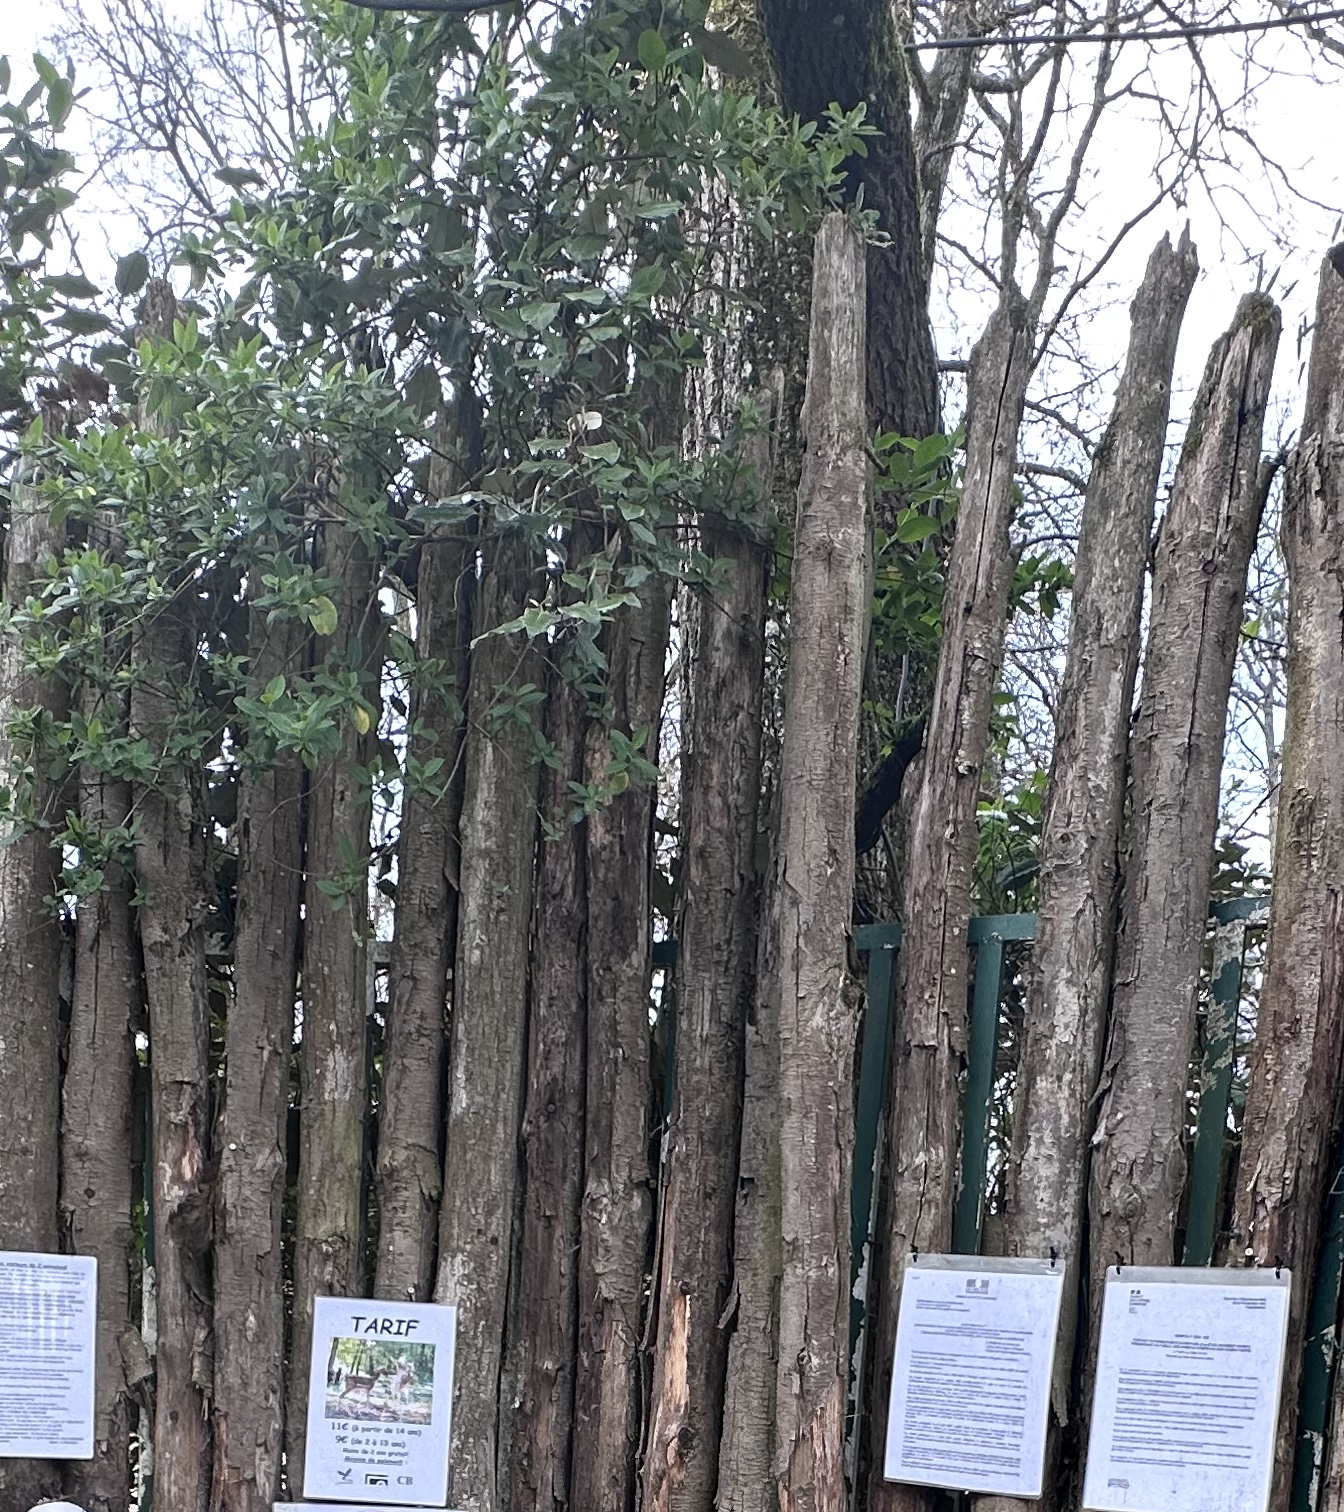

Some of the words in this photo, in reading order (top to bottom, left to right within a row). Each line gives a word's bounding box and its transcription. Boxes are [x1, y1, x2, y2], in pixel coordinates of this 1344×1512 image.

[351, 1316, 420, 1337] TARIF
[331, 1422, 349, 1431] 11€
[335, 1435, 348, 1443] 9€
[397, 1475, 413, 1486] CB
